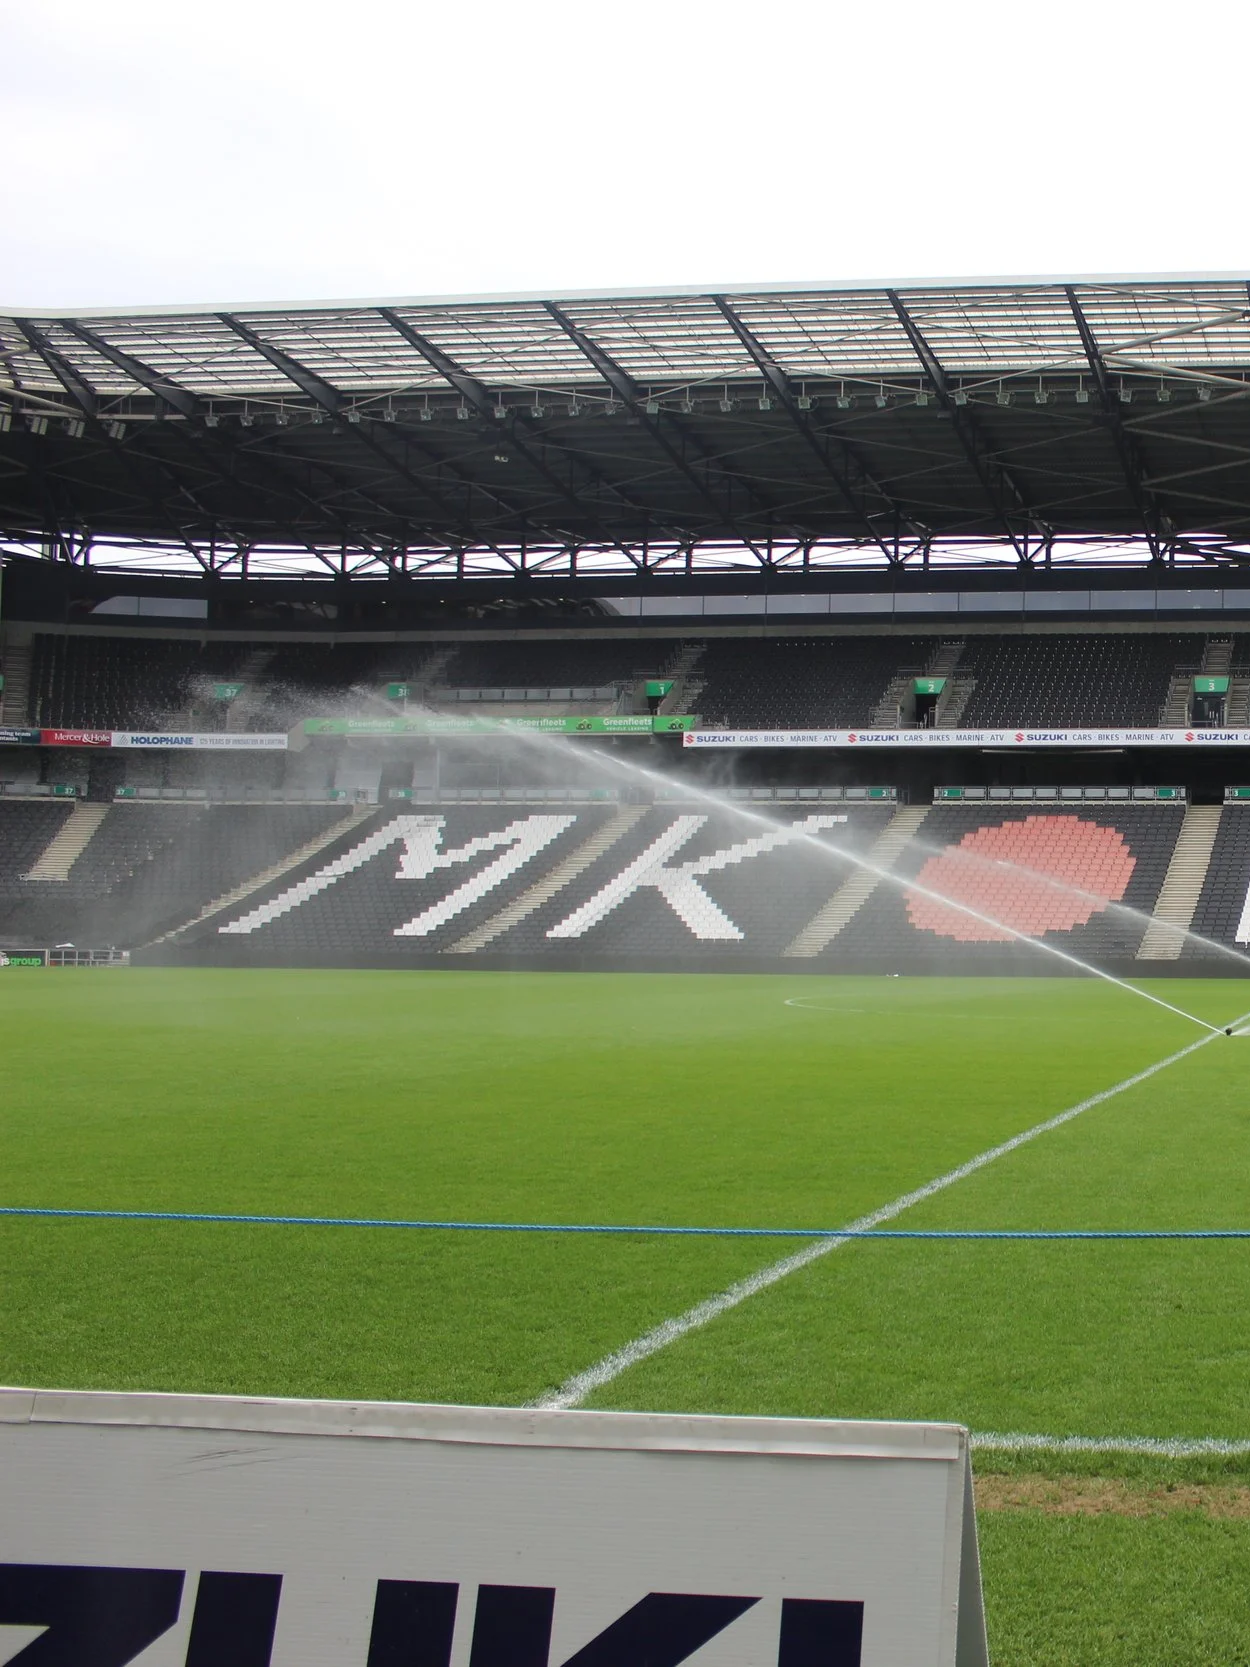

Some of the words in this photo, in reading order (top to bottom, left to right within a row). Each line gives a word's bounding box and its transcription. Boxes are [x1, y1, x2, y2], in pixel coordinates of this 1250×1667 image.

[660, 686, 665, 695] 1
[928, 684, 935, 693] 2
[1208, 682, 1216, 691] 3
[225, 688, 237, 697] 37
[516, 718, 567, 727] Greenfleets
[603, 718, 652, 727] Greenfleets
[131, 736, 194, 745] HOLOPHANE
[697, 735, 735, 743] SUZUKI
[740, 735, 758, 743] CARS
[764, 735, 785, 743] BIKES
[790, 735, 818, 743] MARINE
[823, 735, 838, 743] ATV
[859, 734, 899, 742] SUZUKI
[904, 734, 923, 742] CARS
[929, 734, 950, 742] BIKES
[955, 734, 984, 742] MARINE
[990, 734, 1004, 742] ATV
[1027, 734, 1067, 742] SUZUKI
[1072, 734, 1092, 742] CARS
[1098, 734, 1119, 742] BIKES
[1126, 734, 1154, 742] MARINE
[1159, 734, 1174, 742] ATV
[1197, 733, 1239, 741] SUZUKI
